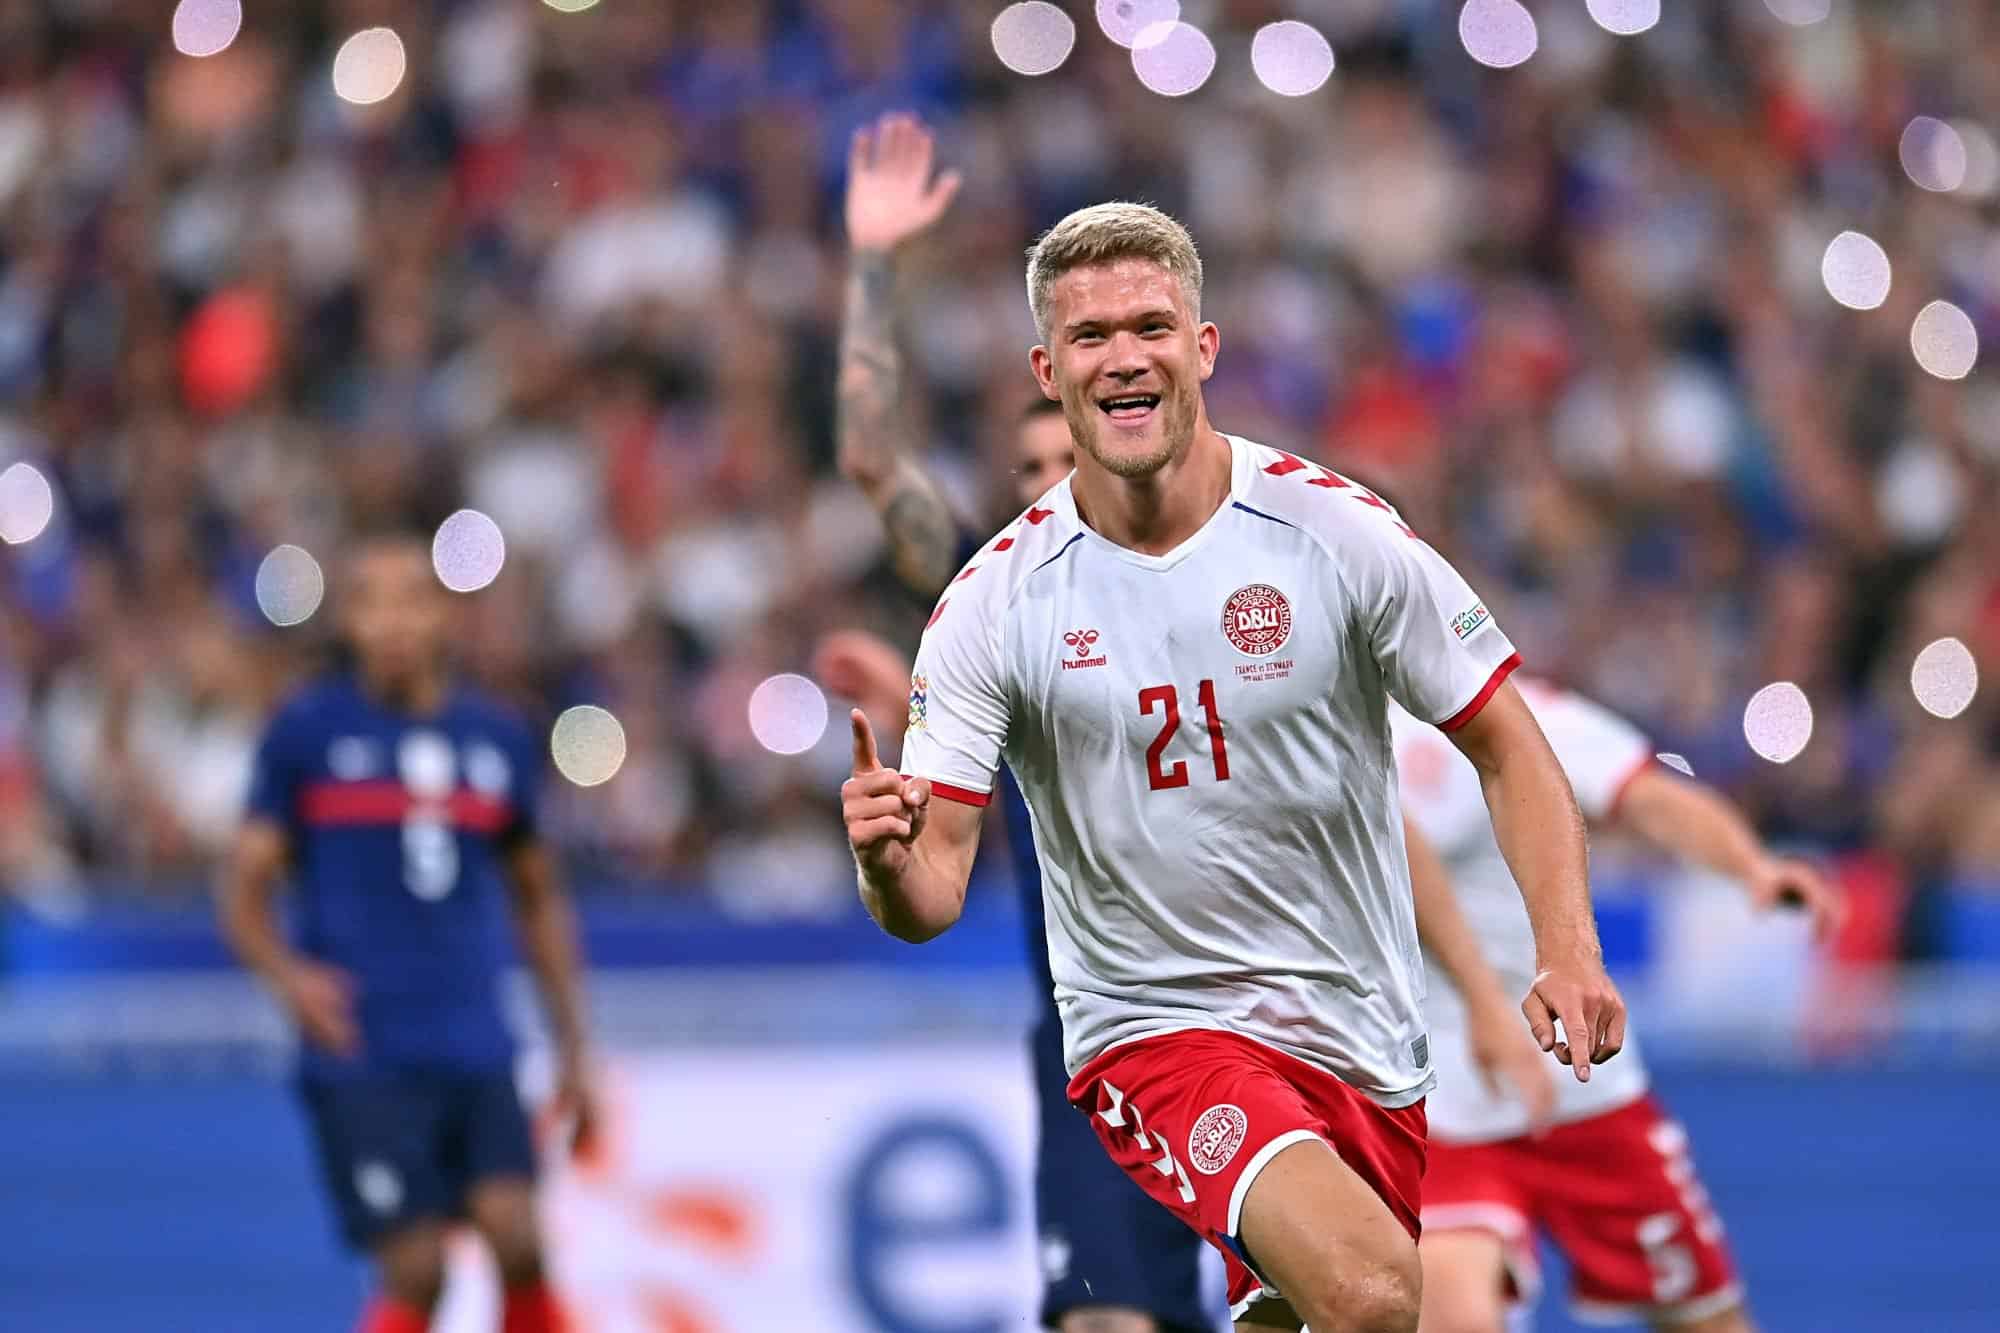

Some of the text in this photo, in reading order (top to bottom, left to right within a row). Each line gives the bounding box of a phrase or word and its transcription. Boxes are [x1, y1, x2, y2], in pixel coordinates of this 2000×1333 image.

[1236, 607, 1280, 631] DBU
[1247, 643, 1277, 655] 1889
[1061, 654, 1107, 670] hummel
[1137, 679, 1231, 791] 21
[1201, 1117, 1234, 1159] DBU
